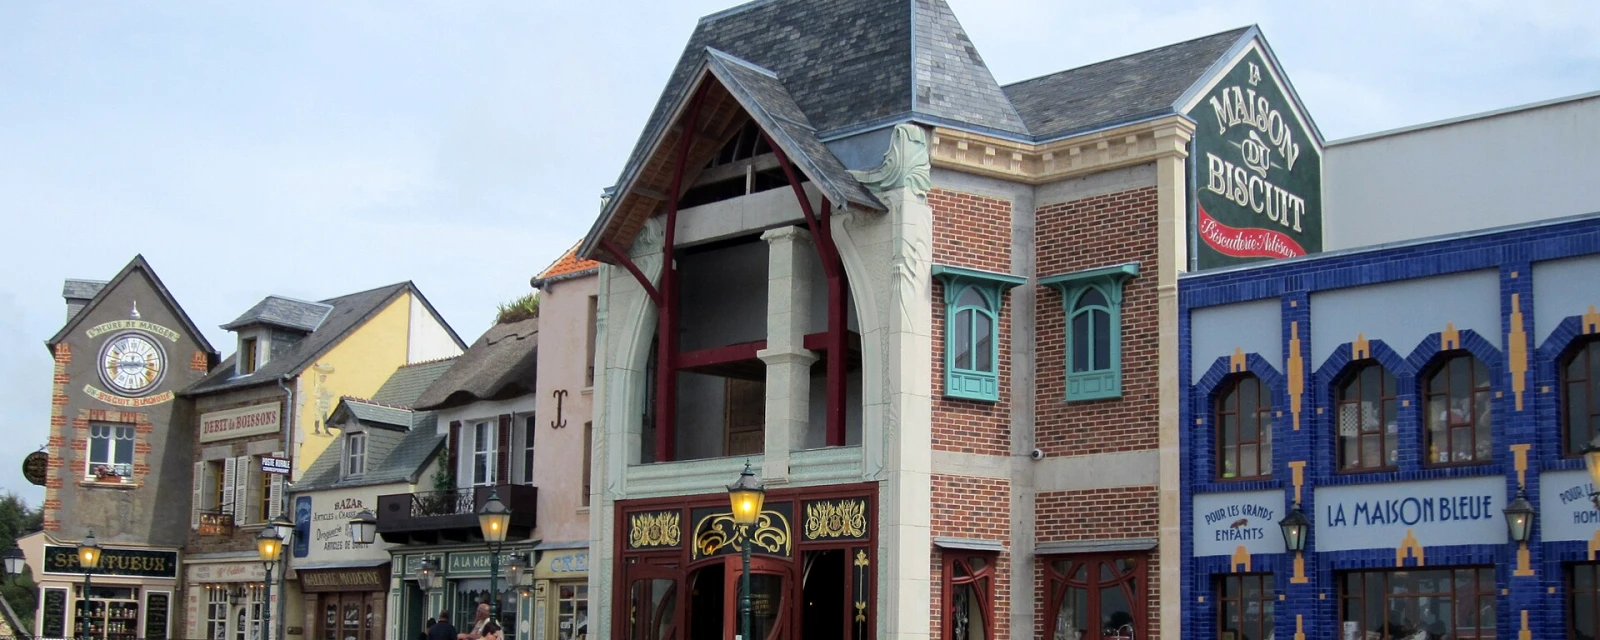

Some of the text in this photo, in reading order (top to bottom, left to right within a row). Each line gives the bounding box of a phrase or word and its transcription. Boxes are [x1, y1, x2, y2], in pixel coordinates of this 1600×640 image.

[1249, 62, 1261, 86] LA
[1210, 86, 1300, 171] MAISON
[1242, 136, 1270, 173] DU
[1207, 152, 1305, 233] BISCUIT
[1201, 218, 1257, 251] Biscuiterie
[139, 321, 176, 340] MANGER
[98, 391, 130, 405] BISCUIT
[204, 418, 228, 434] DEBIT
[236, 411, 276, 429] BOISSONS
[334, 498, 362, 510] BAZAR
[1559, 485, 1585, 505] POUR
[1205, 504, 1274, 525] POUR LES GRANDS
[1328, 495, 1492, 527] LA MAISON BLEUE
[1574, 510, 1600, 524] HOM
[1215, 527, 1264, 541] ENFANTS
[54, 553, 165, 571] SPITUEUX
[461, 556, 471, 568] LA
[551, 552, 589, 572] CRE
[304, 571, 379, 586] GALERIE MODERNE
